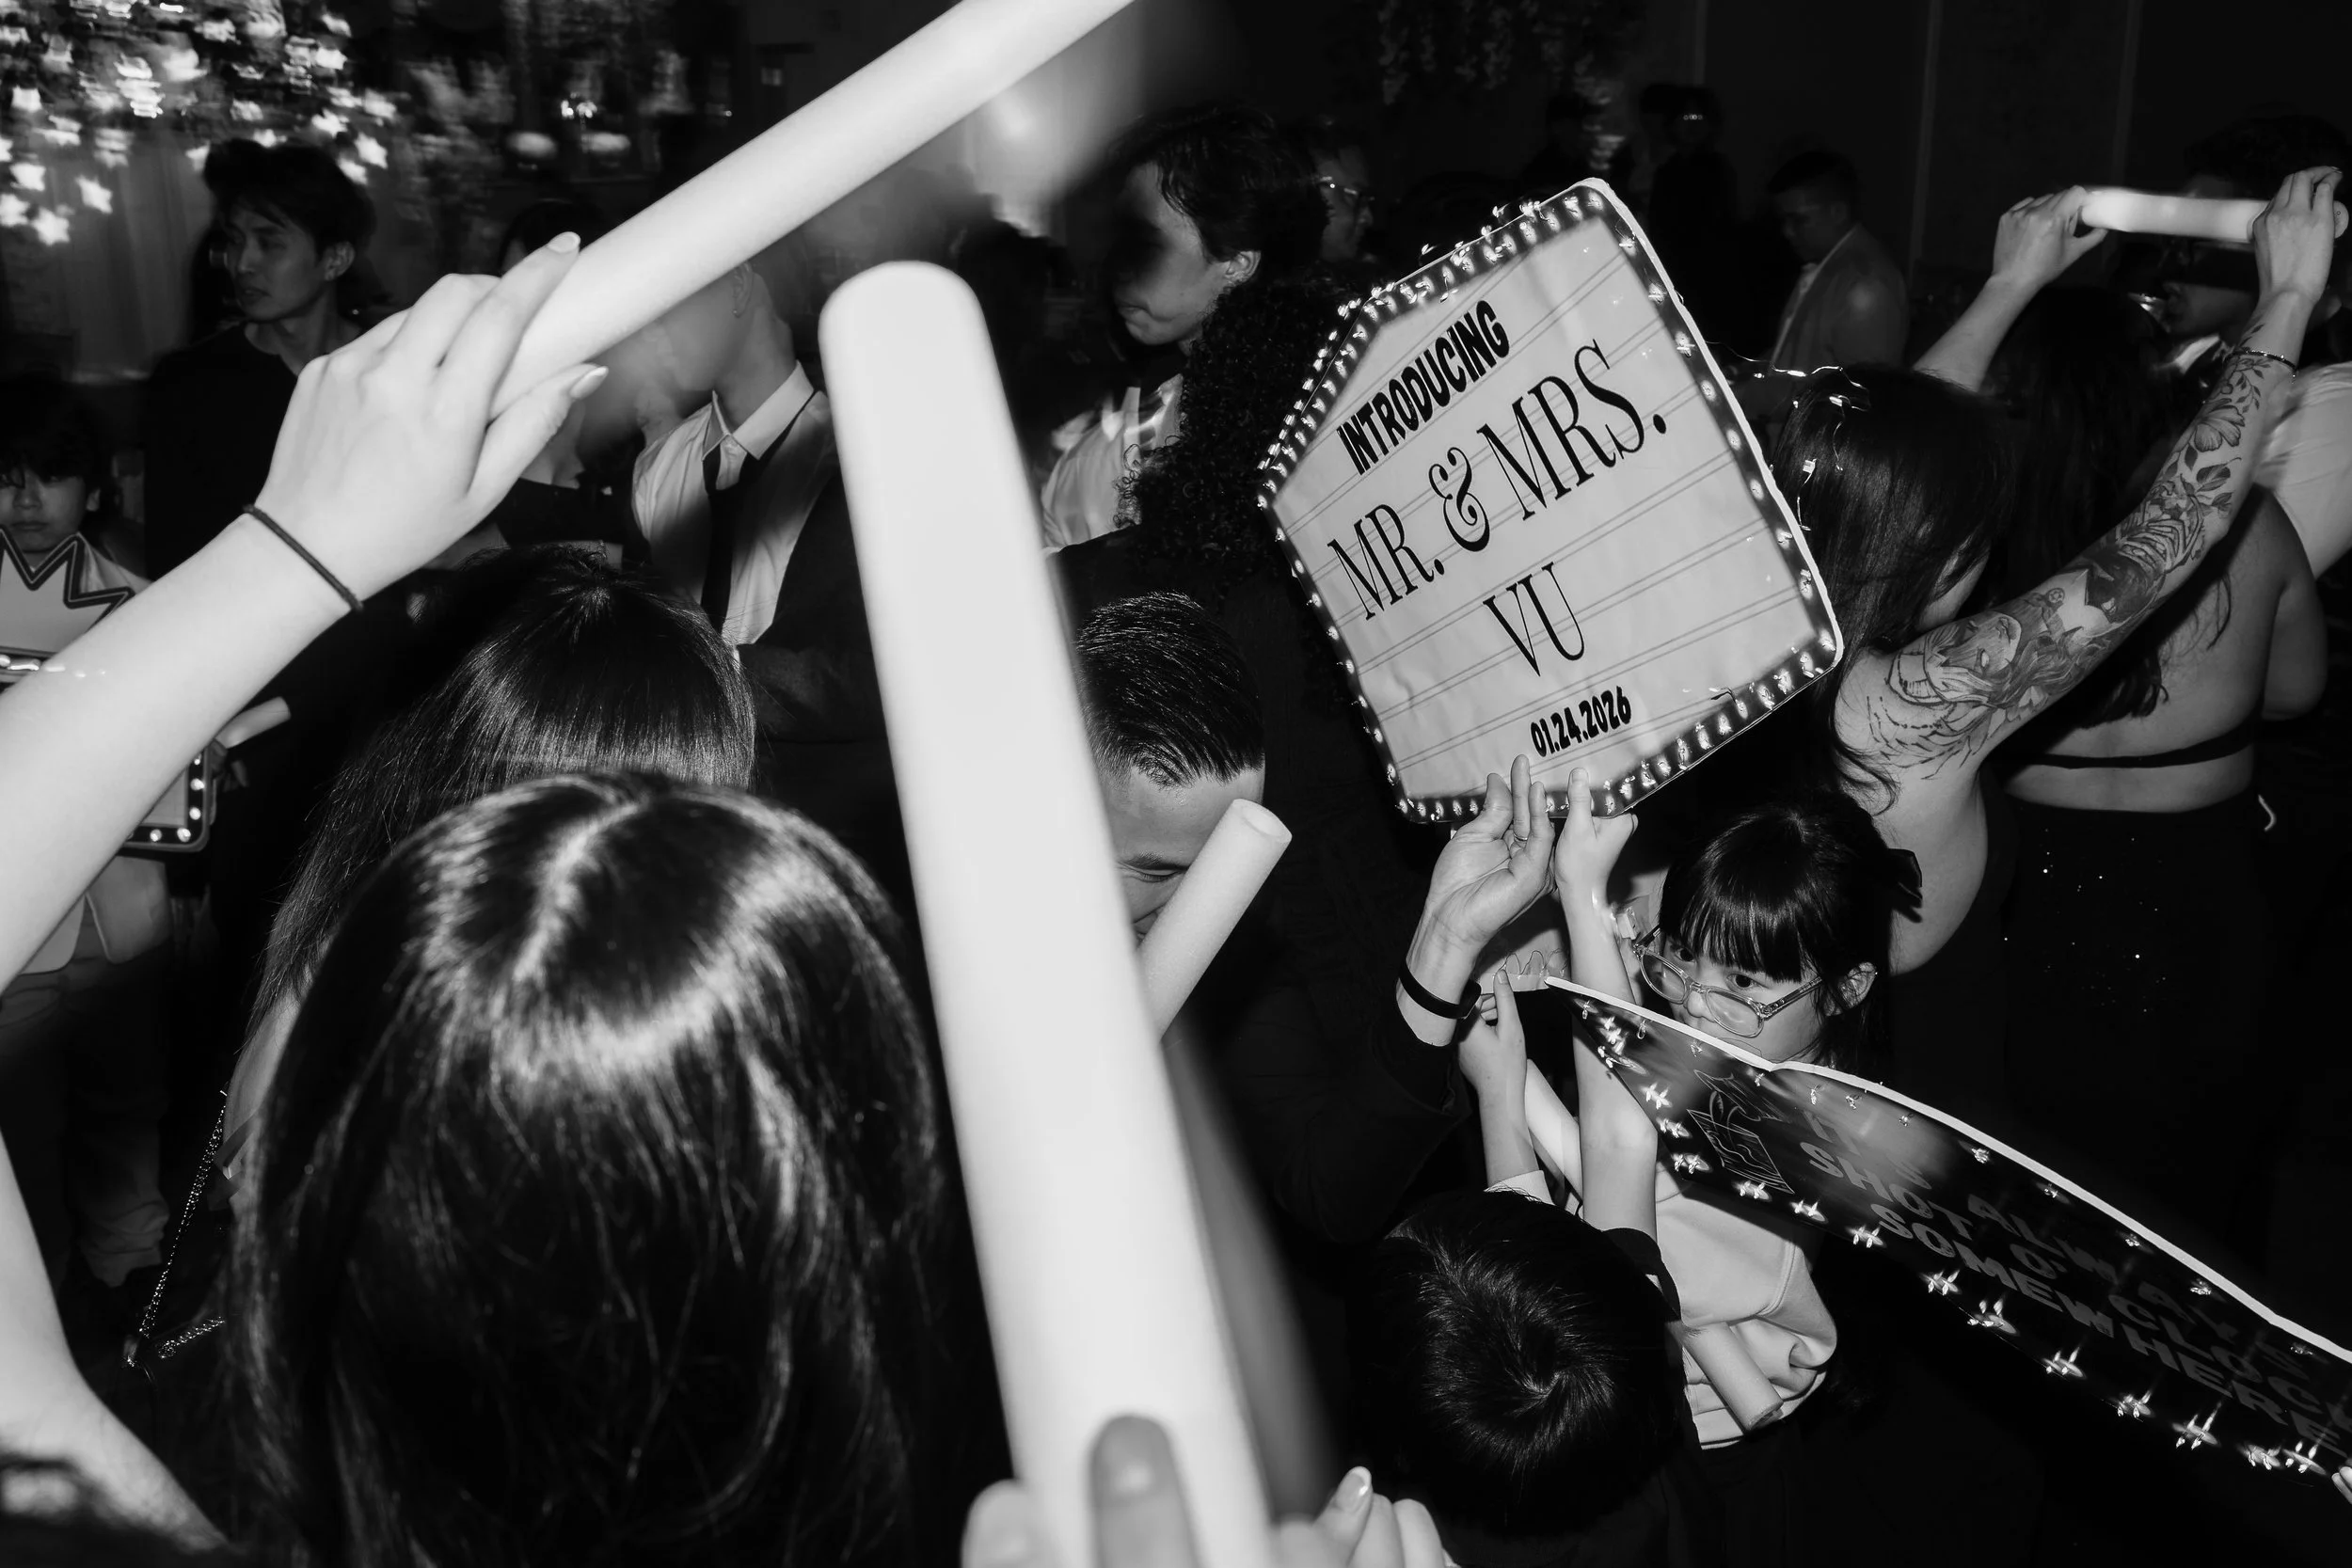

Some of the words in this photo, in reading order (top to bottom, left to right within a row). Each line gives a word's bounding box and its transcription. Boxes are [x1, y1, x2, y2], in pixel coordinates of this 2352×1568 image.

[1336, 300, 1509, 475] INTRODUCING
[1327, 503, 1445, 620] MR.
[1428, 447, 1491, 552] &
[1476, 339, 1667, 522] MRS.
[1482, 562, 1585, 677] VU
[1531, 686, 1631, 757] 01.24.2026
[1799, 1141, 1974, 1241] SHOT
[1870, 1203, 2348, 1459] SOMEWHERE
[1967, 1194, 2311, 1382] ALWAYS
